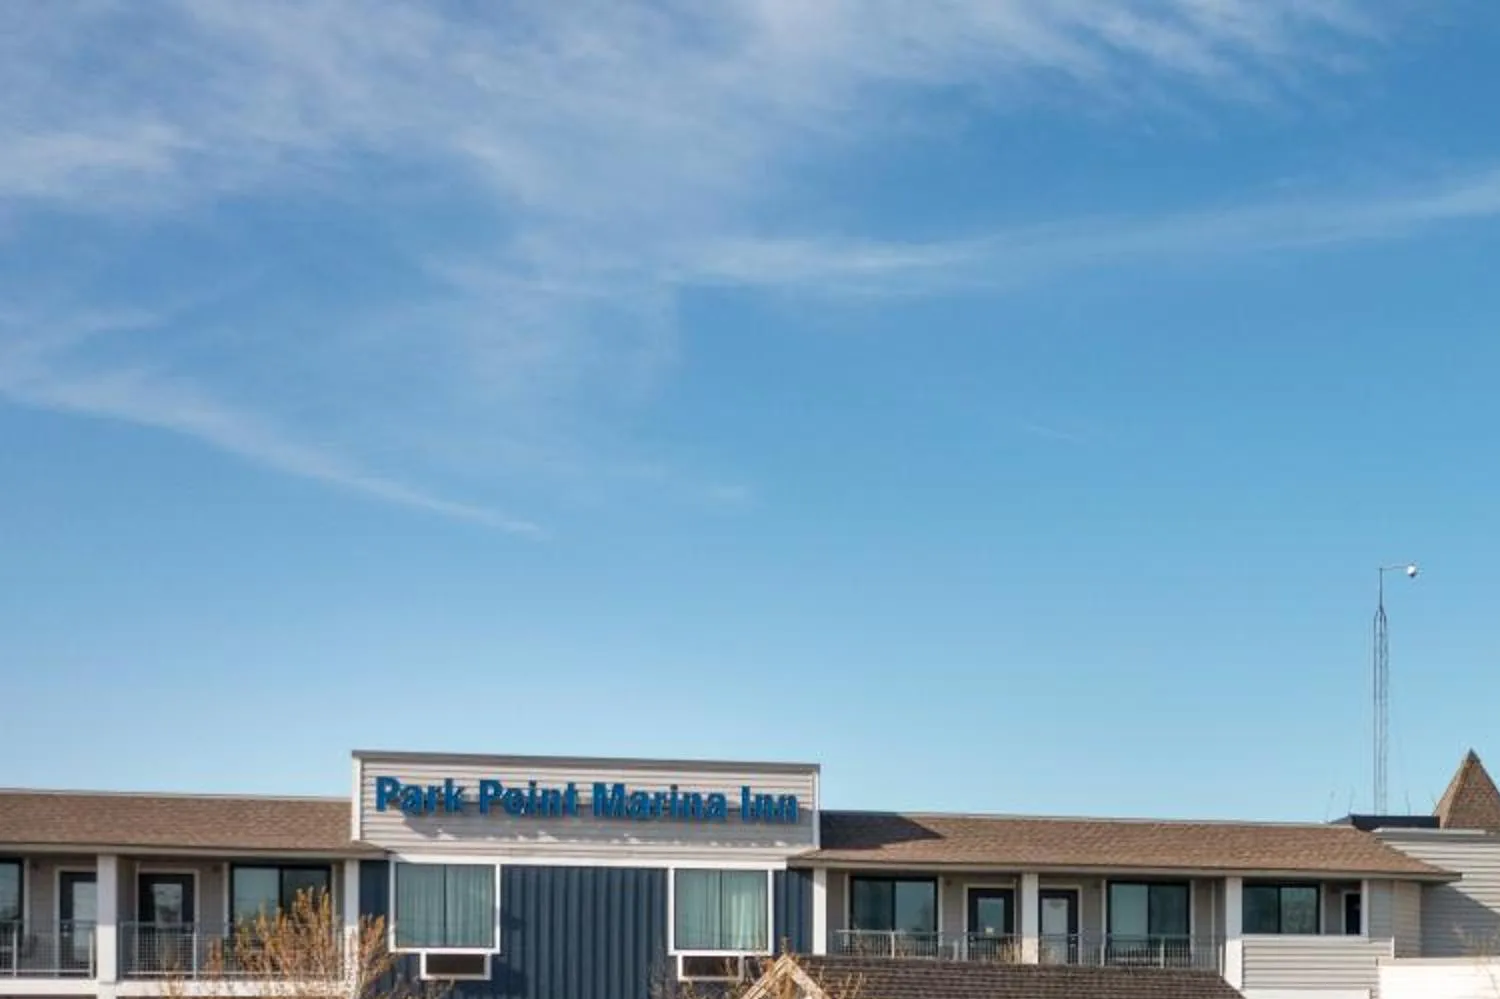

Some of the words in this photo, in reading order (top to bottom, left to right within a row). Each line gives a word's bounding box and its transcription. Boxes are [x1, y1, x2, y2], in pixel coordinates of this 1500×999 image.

[375, 776, 464, 815] Park
[479, 779, 579, 818] Point
[592, 782, 728, 821] Marina
[741, 785, 798, 823] Inn
